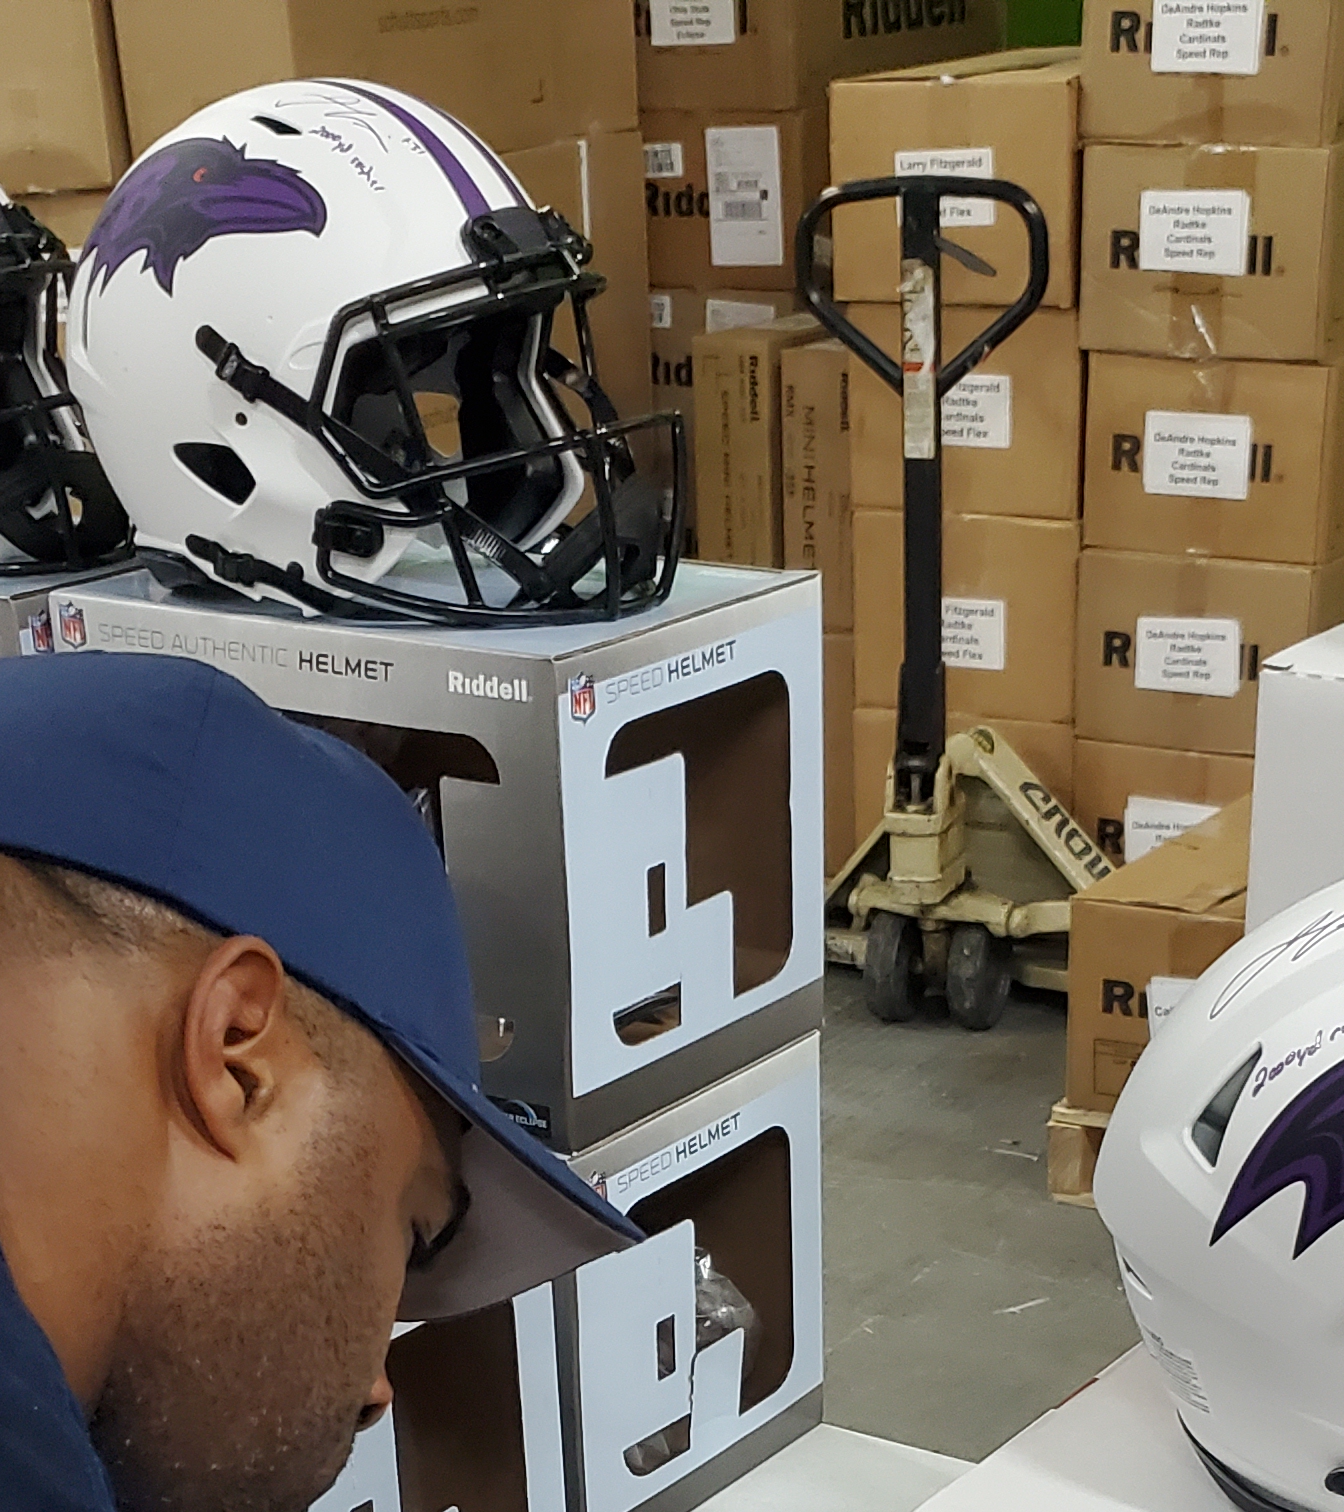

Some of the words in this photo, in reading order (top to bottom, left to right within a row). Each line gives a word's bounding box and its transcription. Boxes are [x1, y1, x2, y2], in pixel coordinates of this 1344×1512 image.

[1206, 4, 1248, 15] Hopkins
[900, 159, 926, 173] Larry
[930, 157, 983, 170] Fitzgerald
[1153, 433, 1195, 443] DeAndre
[1197, 435, 1236, 447] Hopkins
[98, 623, 165, 650] SPEED
[170, 633, 288, 668] AUTHENTIC
[297, 650, 395, 682] HELMET
[606, 667, 664, 704] SPEED
[668, 640, 737, 682] HELMET
[447, 670, 530, 702] Riddell
[515, 1113, 548, 1130] ECLIPSE
[617, 1151, 672, 1194] SPEED
[675, 1112, 741, 1163] HELMET
